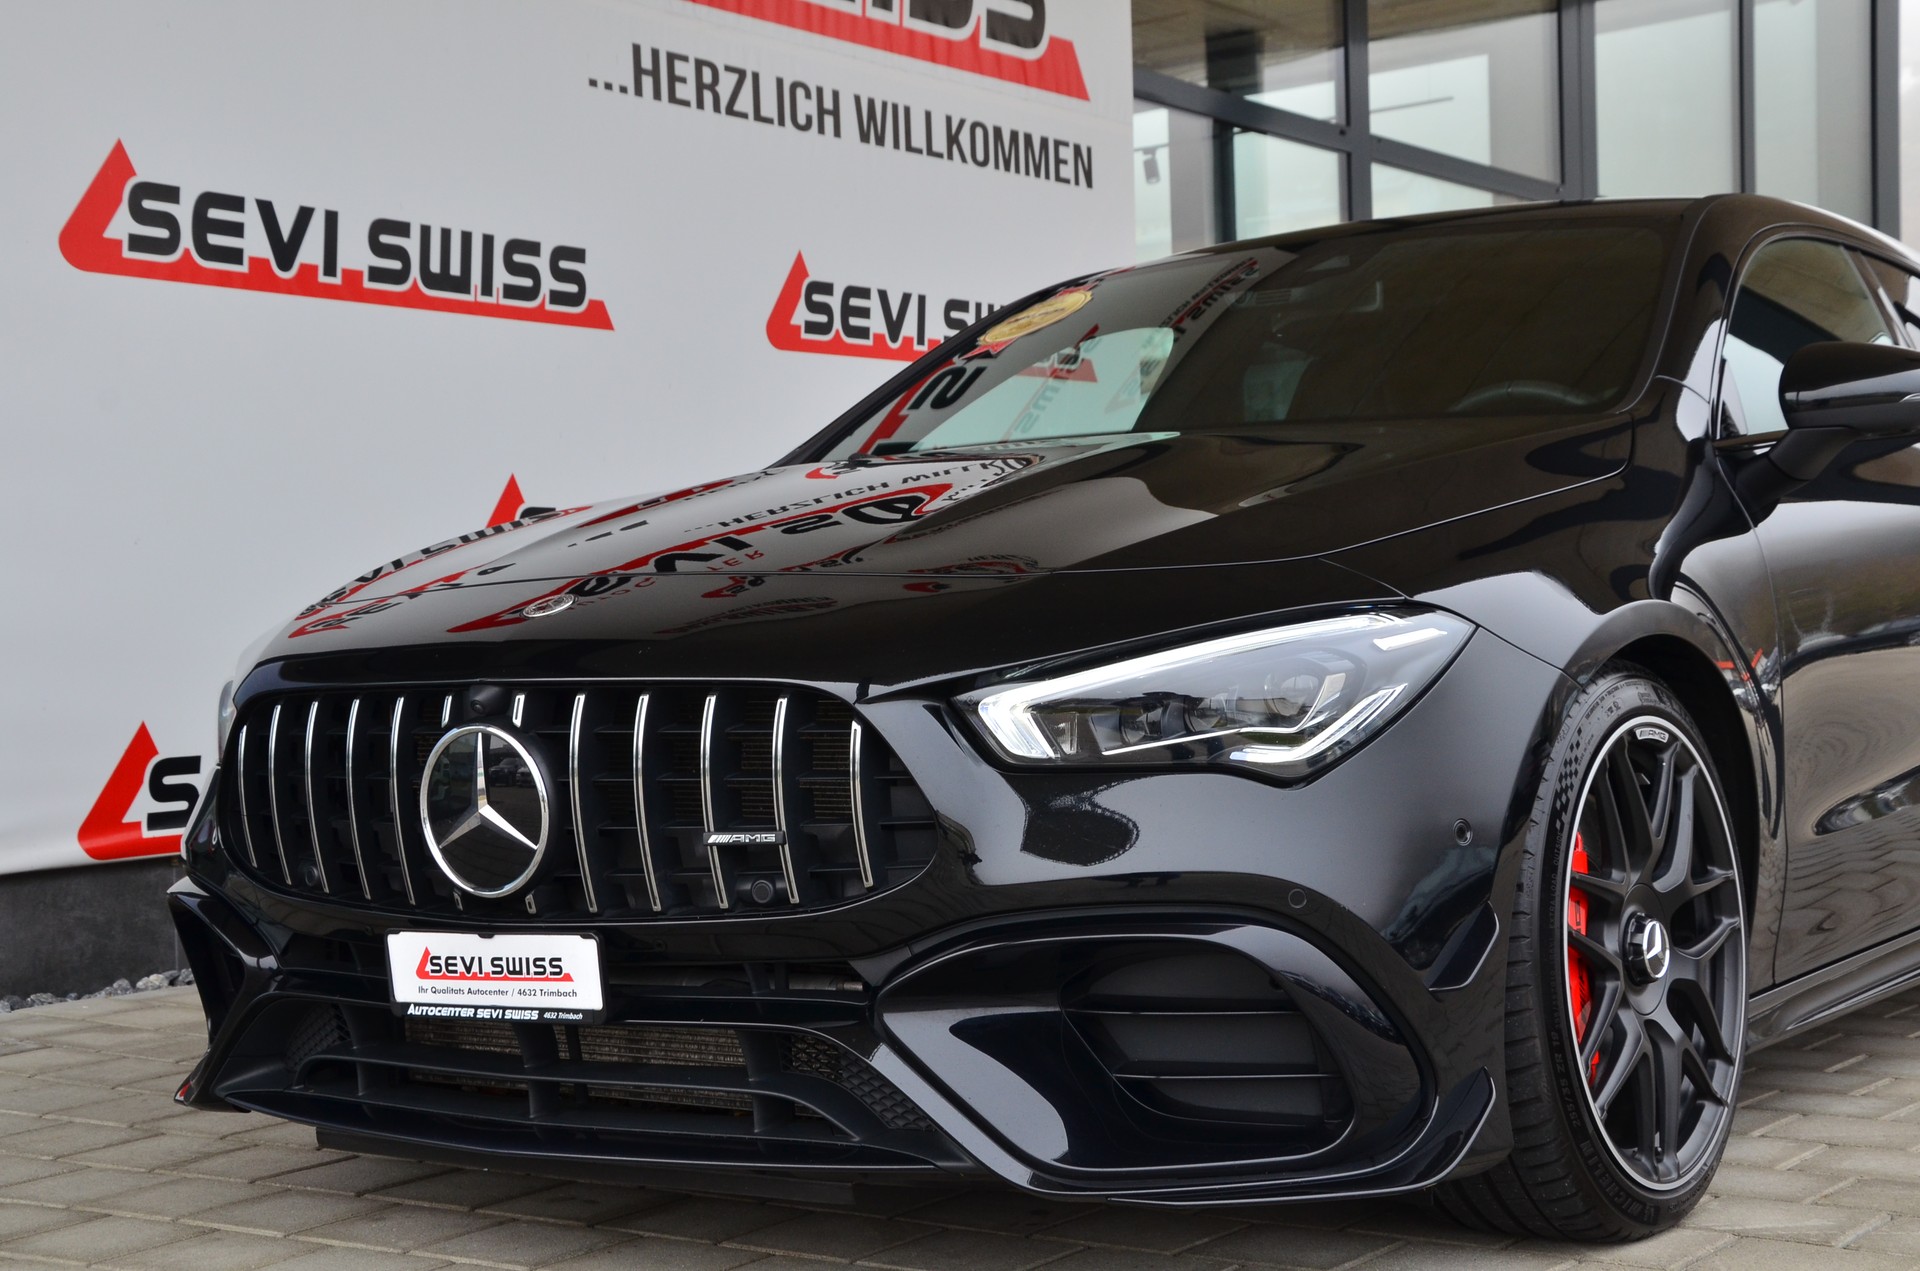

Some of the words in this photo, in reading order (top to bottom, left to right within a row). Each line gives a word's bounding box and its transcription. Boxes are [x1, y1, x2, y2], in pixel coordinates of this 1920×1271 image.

[853, 93, 1094, 189] WILLKOMMEN
[127, 181, 339, 279] SEVI
[367, 217, 586, 308] SWISS
[803, 280, 927, 346] SEVI
[729, 833, 775, 843] AMG
[429, 956, 483, 975] SEVI
[490, 957, 563, 976] SWISS
[418, 986, 428, 994] Ihr
[467, 988, 509, 996] Autocenter
[517, 988, 538, 997] 4632
[539, 988, 578, 998] Trimbach
[407, 1003, 475, 1018] AUTOCENTER
[476, 1008, 503, 1019] SEVI
[504, 1008, 539, 1020] SWISS
[543, 1011, 558, 1020] 4632
[557, 1012, 583, 1020] Trimbach
